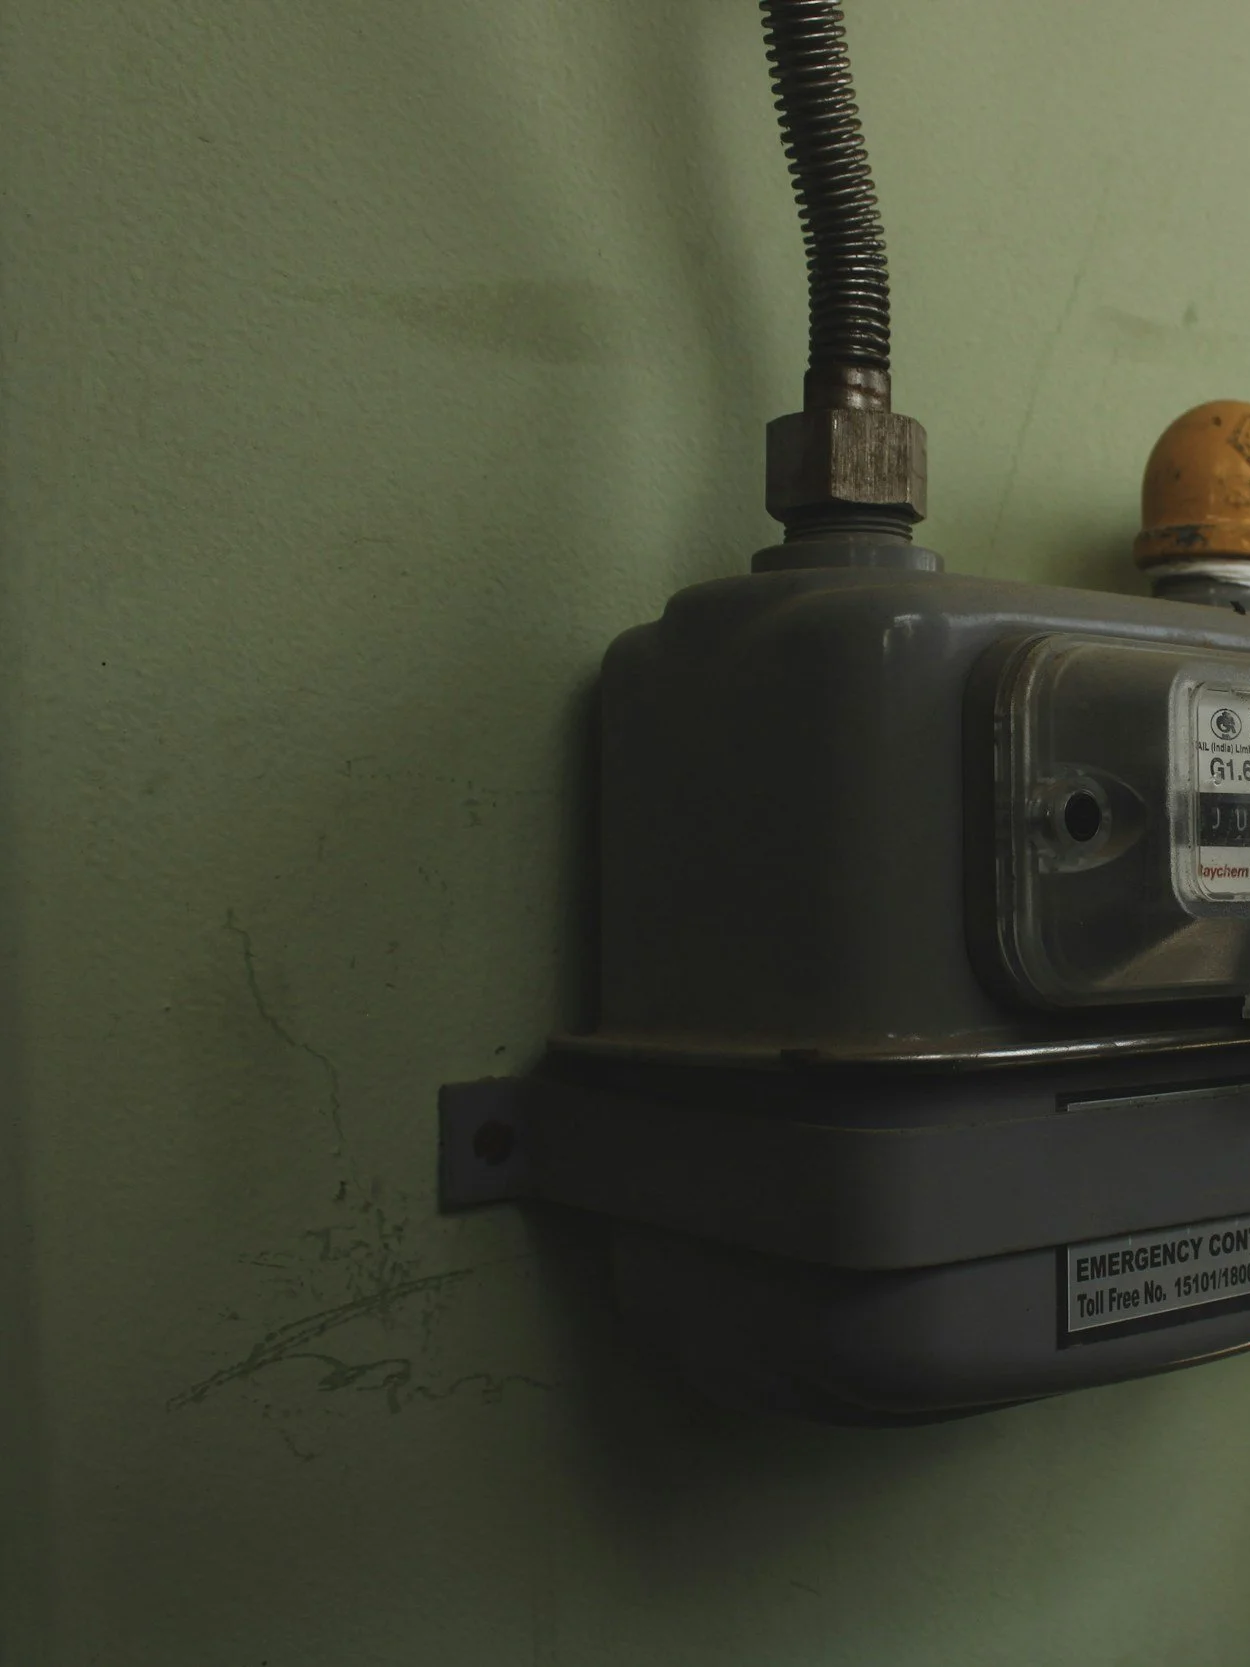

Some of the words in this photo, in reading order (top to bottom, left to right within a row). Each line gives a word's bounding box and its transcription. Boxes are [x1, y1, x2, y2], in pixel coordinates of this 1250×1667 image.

[1196, 741, 1210, 752] AIL
[1211, 742, 1233, 754] (India)
[1077, 1237, 1204, 1282] EMERGENCY
[1077, 1290, 1104, 1318] Toll
[1109, 1287, 1140, 1312] Free
